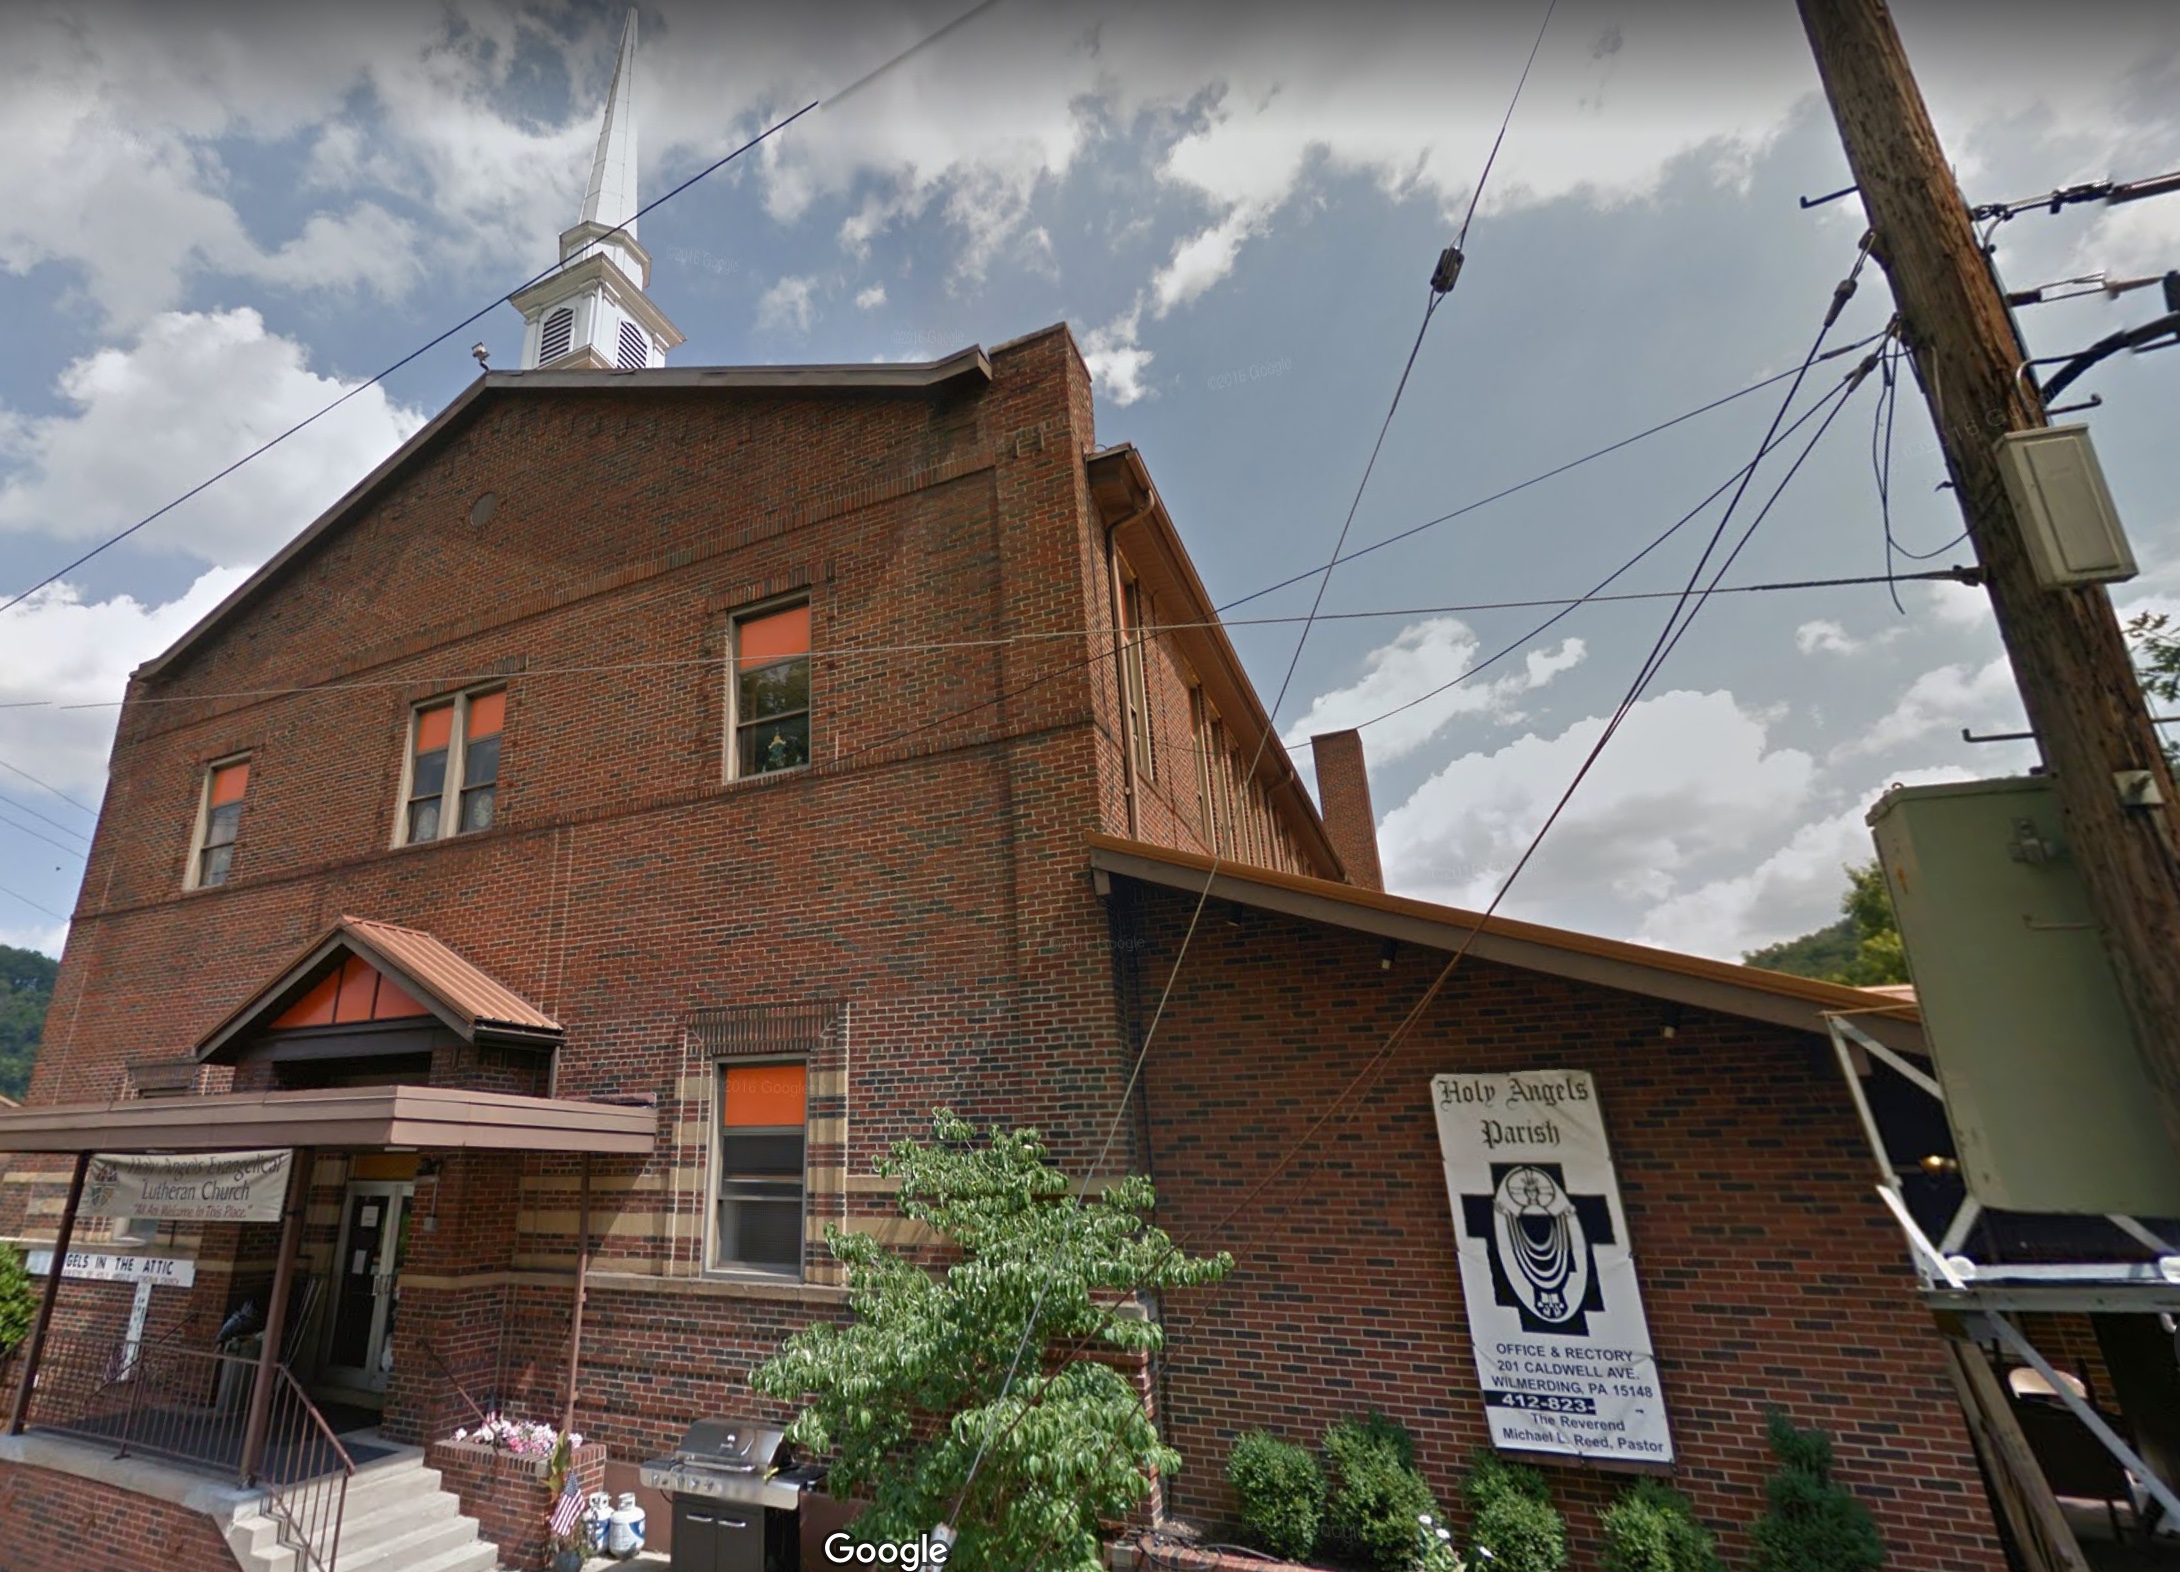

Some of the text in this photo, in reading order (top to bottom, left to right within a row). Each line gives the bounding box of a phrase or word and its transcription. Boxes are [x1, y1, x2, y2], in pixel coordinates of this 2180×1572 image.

[1437, 1077, 1589, 1112] Holy Angels
[1481, 1119, 1561, 1149] Parish
[162, 1157, 204, 1181] Angels
[141, 1178, 250, 1201] Lutheran Church
[65, 1254, 174, 1275] GELS IN THE ATTIC
[1496, 1343, 1633, 1363] OFFICE & RECTORY
[1497, 1360, 1641, 1380] 201 CALDWELL AVE.
[1491, 1376, 1654, 1399] WILMERDING, PA 15148
[1531, 1412, 1625, 1432] The Reverend
[1502, 1428, 1554, 1443] Michael
[1573, 1435, 1614, 1450] Reed,
[1618, 1438, 1664, 1453] Pastor
